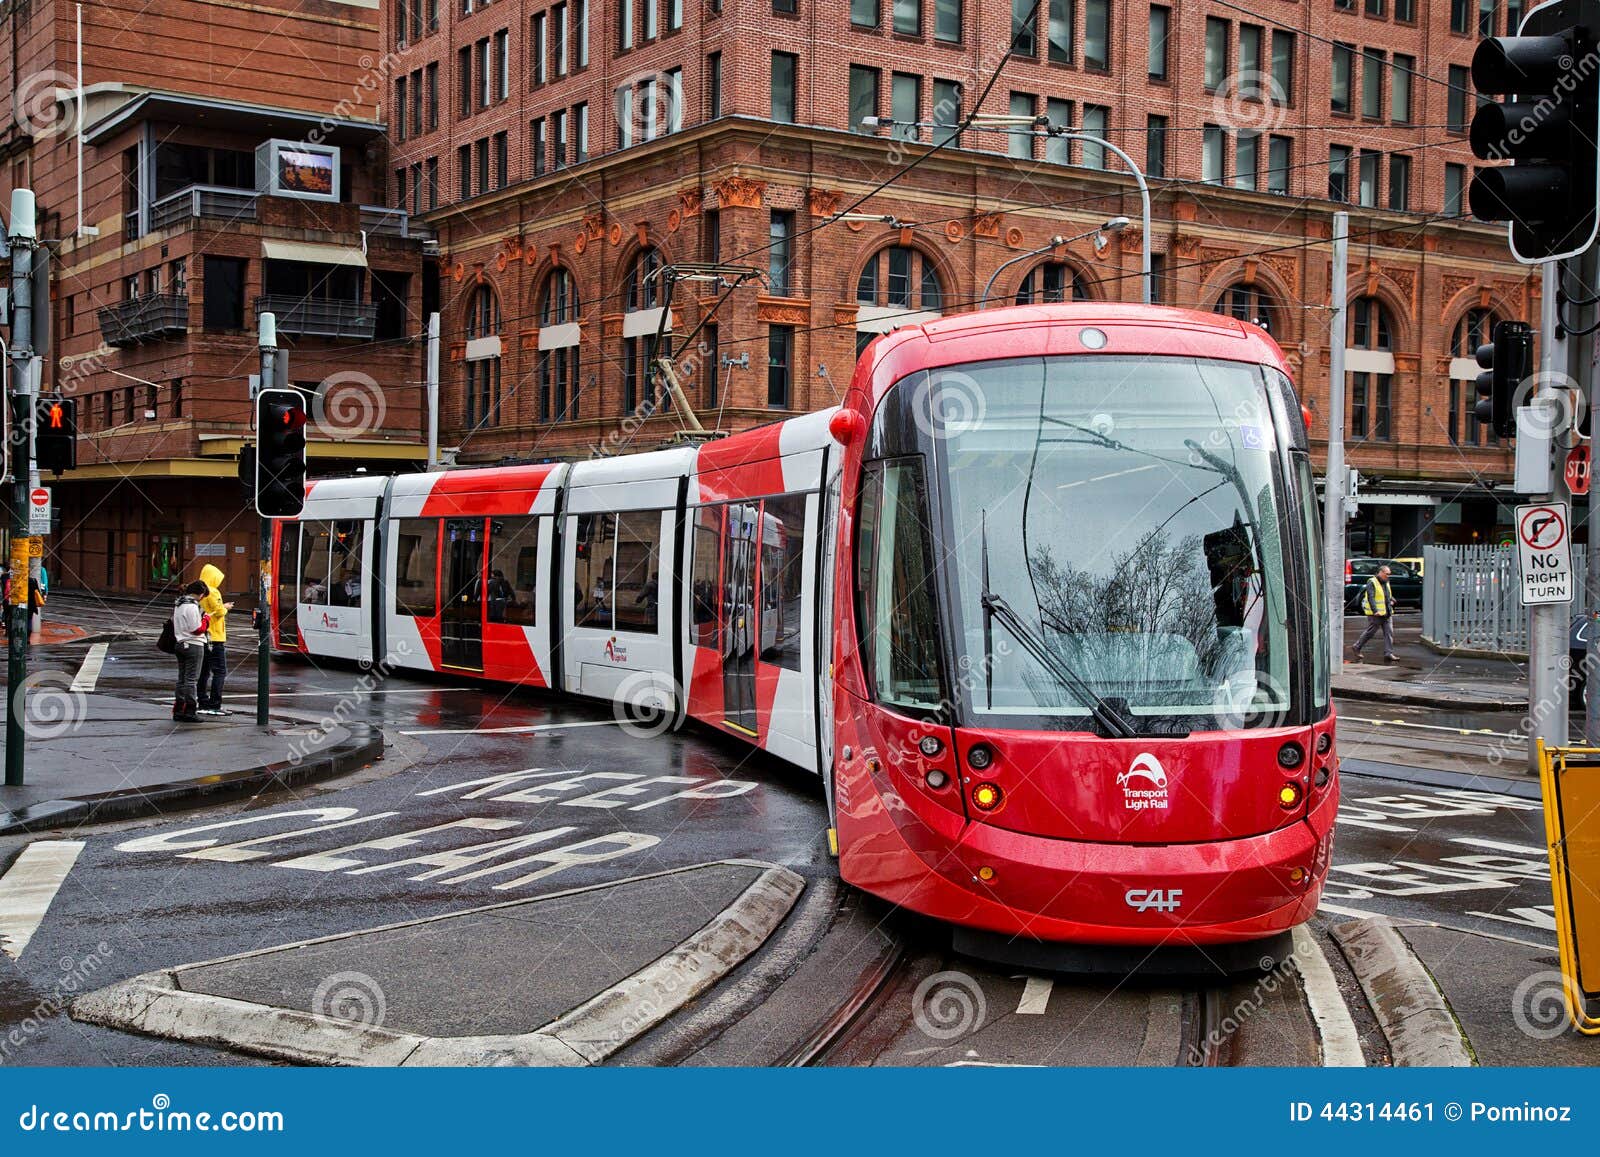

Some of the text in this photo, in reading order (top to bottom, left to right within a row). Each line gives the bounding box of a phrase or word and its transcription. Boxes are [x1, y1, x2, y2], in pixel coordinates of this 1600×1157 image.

[1531, 554, 1559, 569] NO
[1526, 571, 1567, 584] RIGHT
[1529, 586, 1566, 598] TURN
[416, 767, 759, 811] KEEP
[1123, 788, 1168, 799] Transport
[1125, 800, 1168, 810] Light Rail
[113, 807, 661, 890] CLEAR
[1125, 889, 1182, 912] CAF
